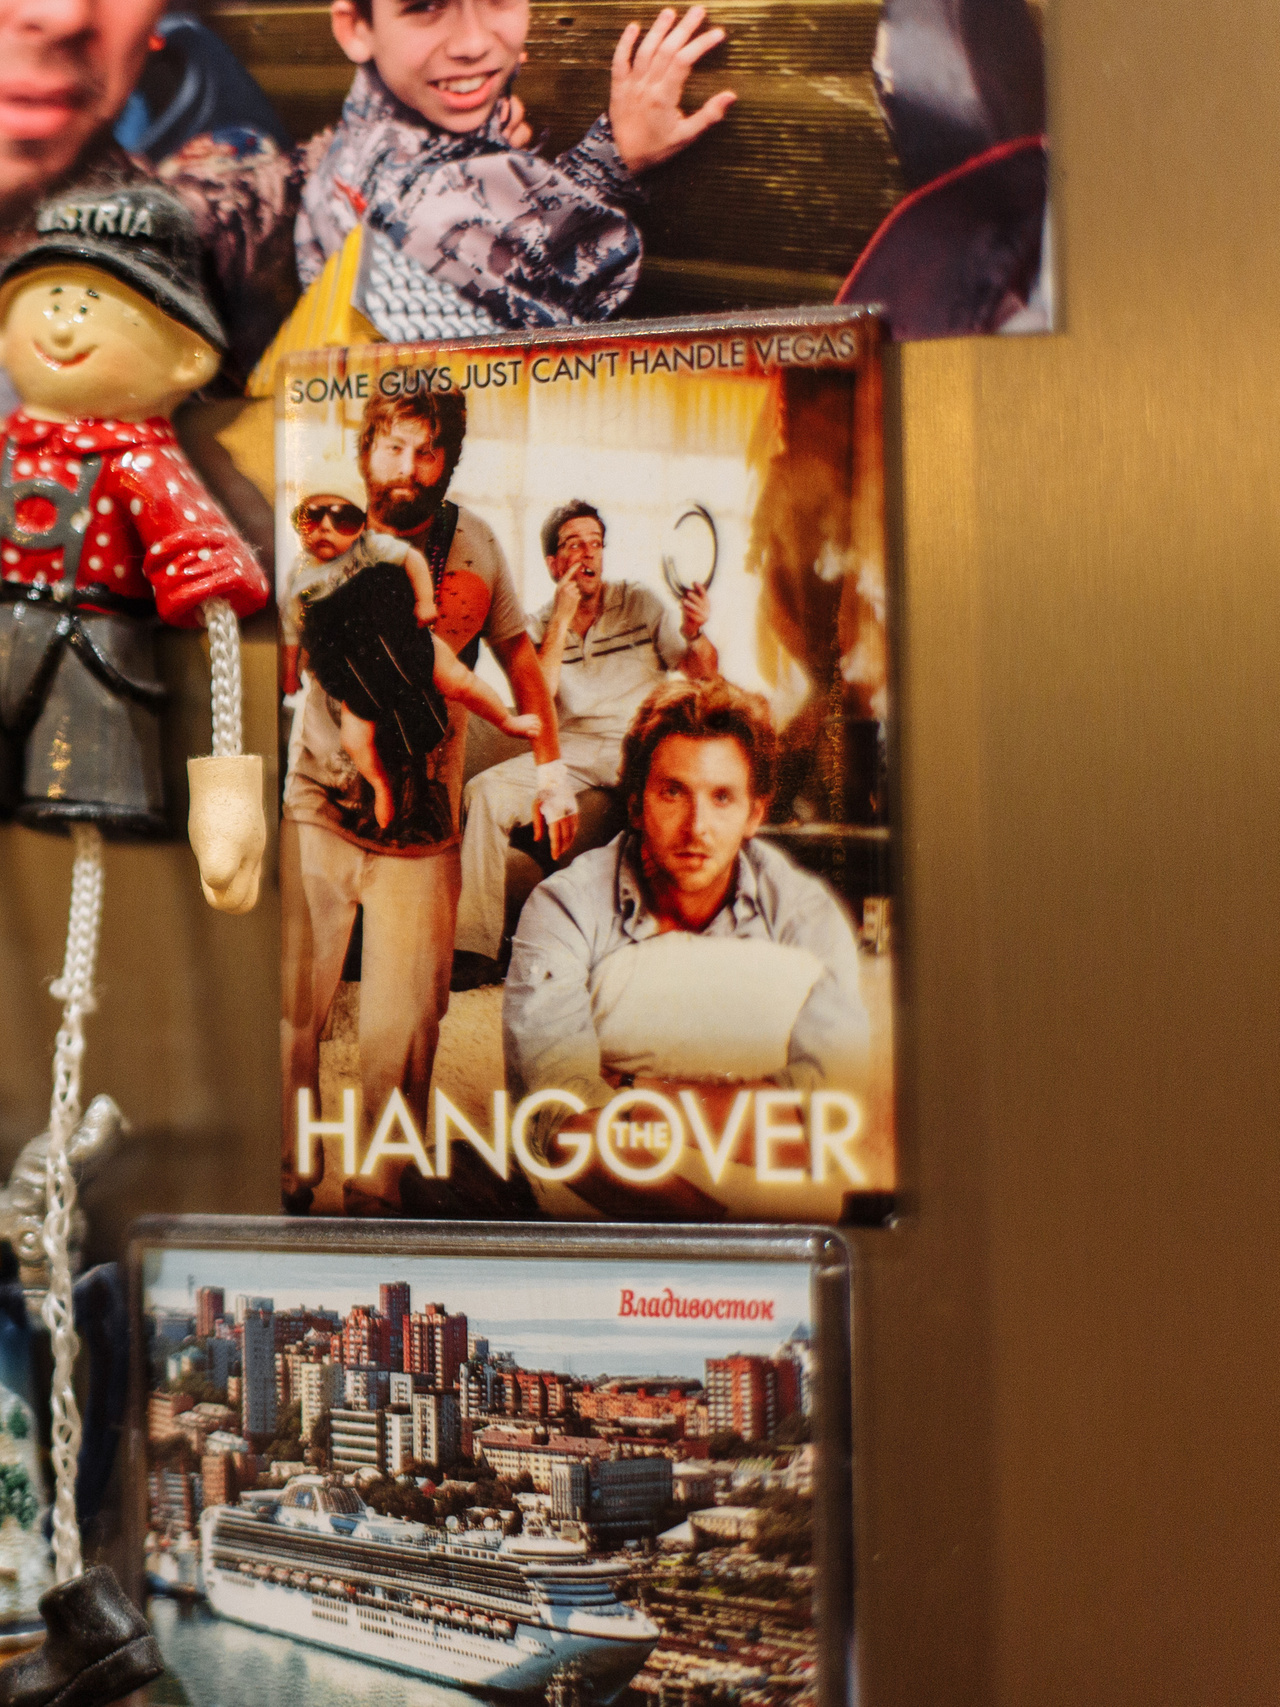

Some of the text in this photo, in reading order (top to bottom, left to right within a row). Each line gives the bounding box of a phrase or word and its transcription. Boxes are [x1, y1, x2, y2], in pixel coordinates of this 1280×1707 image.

[290, 332, 856, 405] SOME GUYS JUST CAN'T HANDLE VEGAS
[295, 1086, 869, 1186] HANGOVER
[611, 1120, 670, 1150] THE
[618, 1287, 776, 1322] Владивосток
